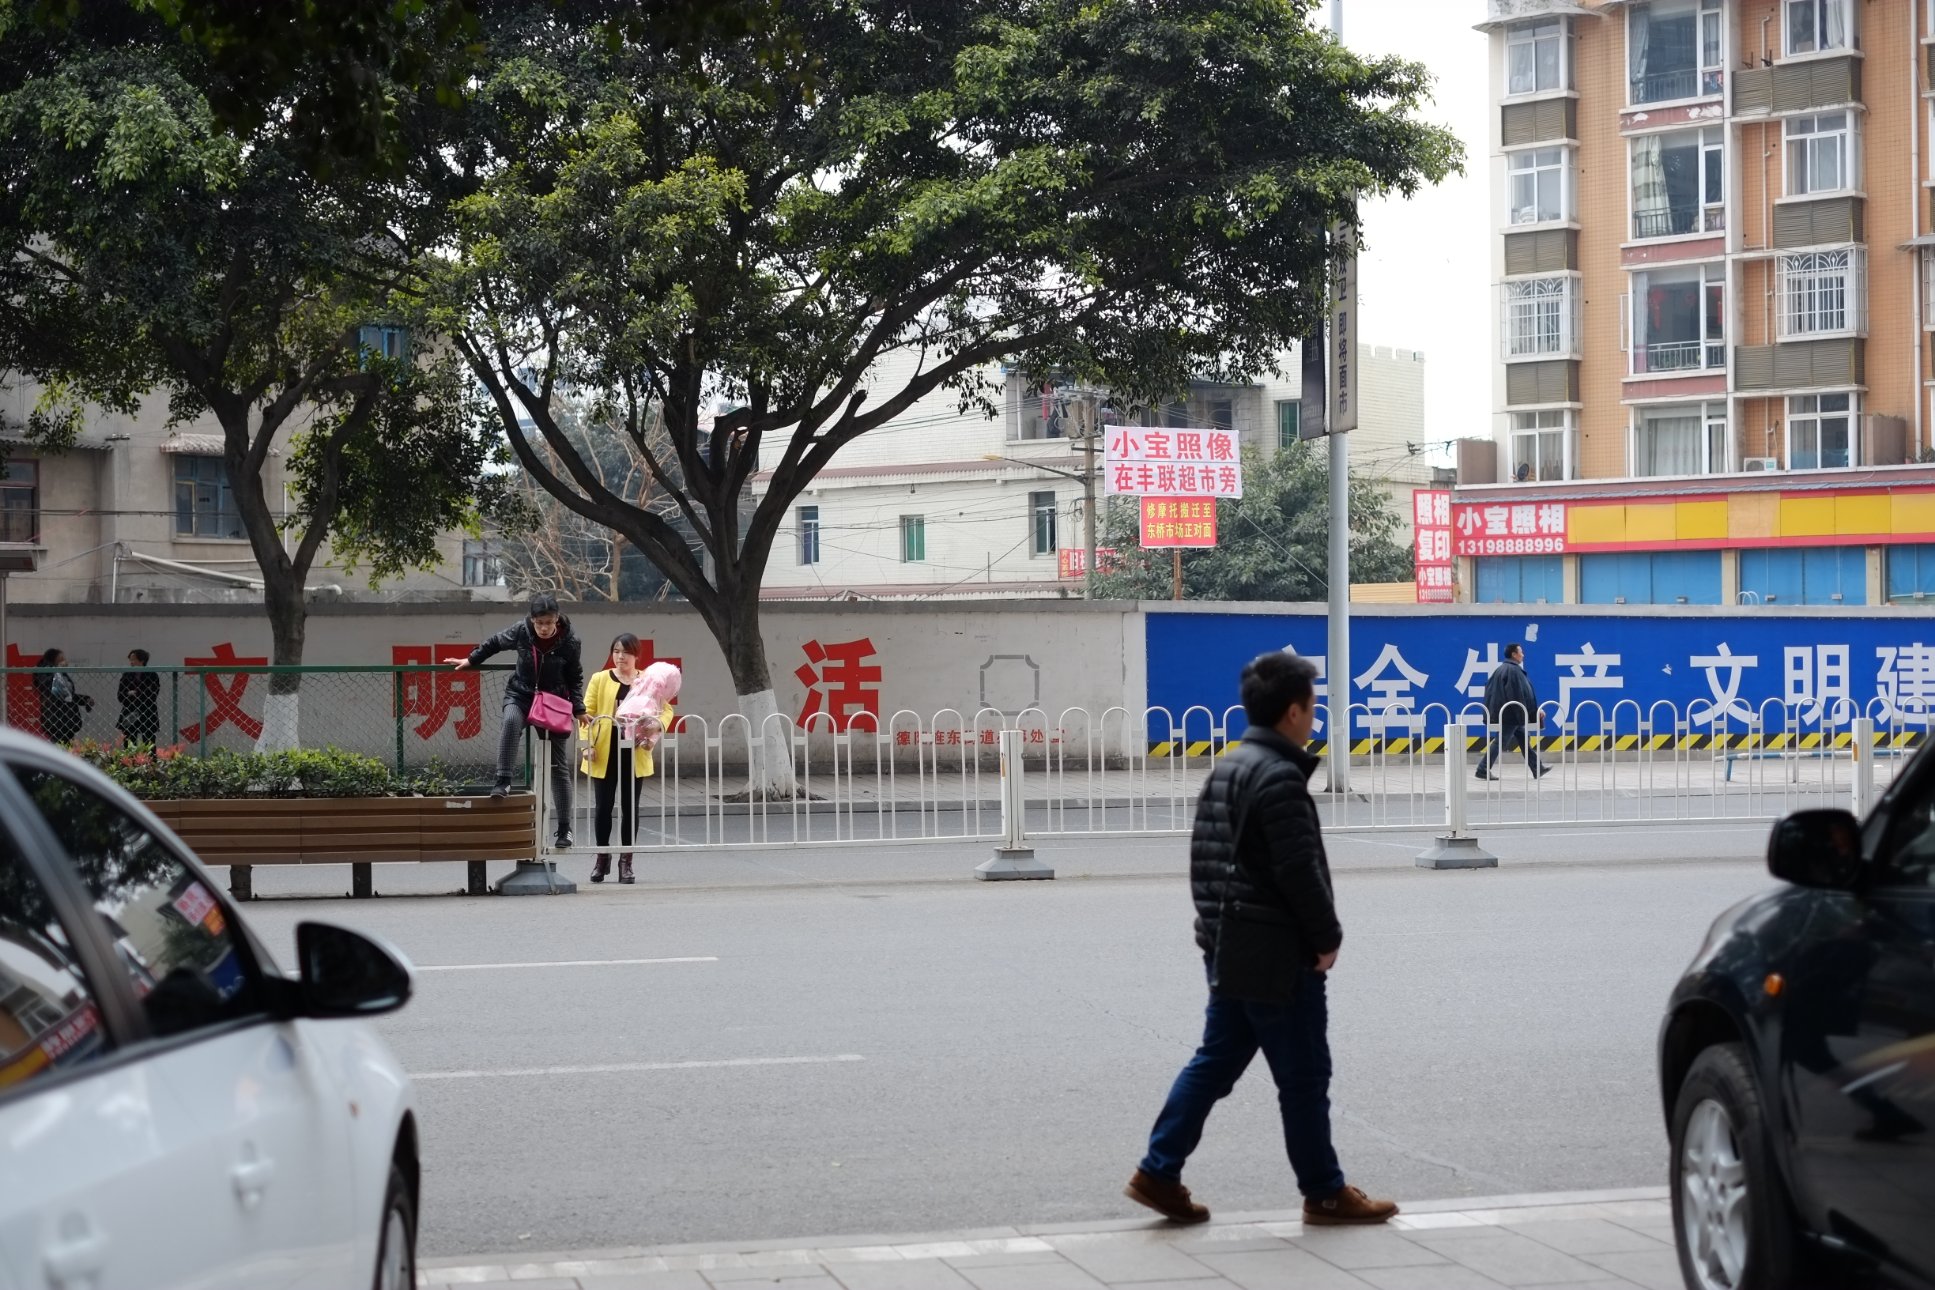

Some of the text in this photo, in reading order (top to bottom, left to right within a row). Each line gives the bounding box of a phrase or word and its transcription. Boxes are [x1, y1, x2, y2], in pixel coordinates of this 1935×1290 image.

[1112, 431, 1234, 460] 小宝照像
[1115, 463, 1236, 493] 在丰联超市旁
[1146, 502, 1212, 519] 修摩托搬迁至
[1416, 493, 1450, 525] 照相
[1457, 504, 1565, 536] 小宝照相
[1147, 522, 1212, 539] 东桥市场正对面
[1417, 529, 1450, 561] 复印
[1458, 538, 1564, 554] 13198888996
